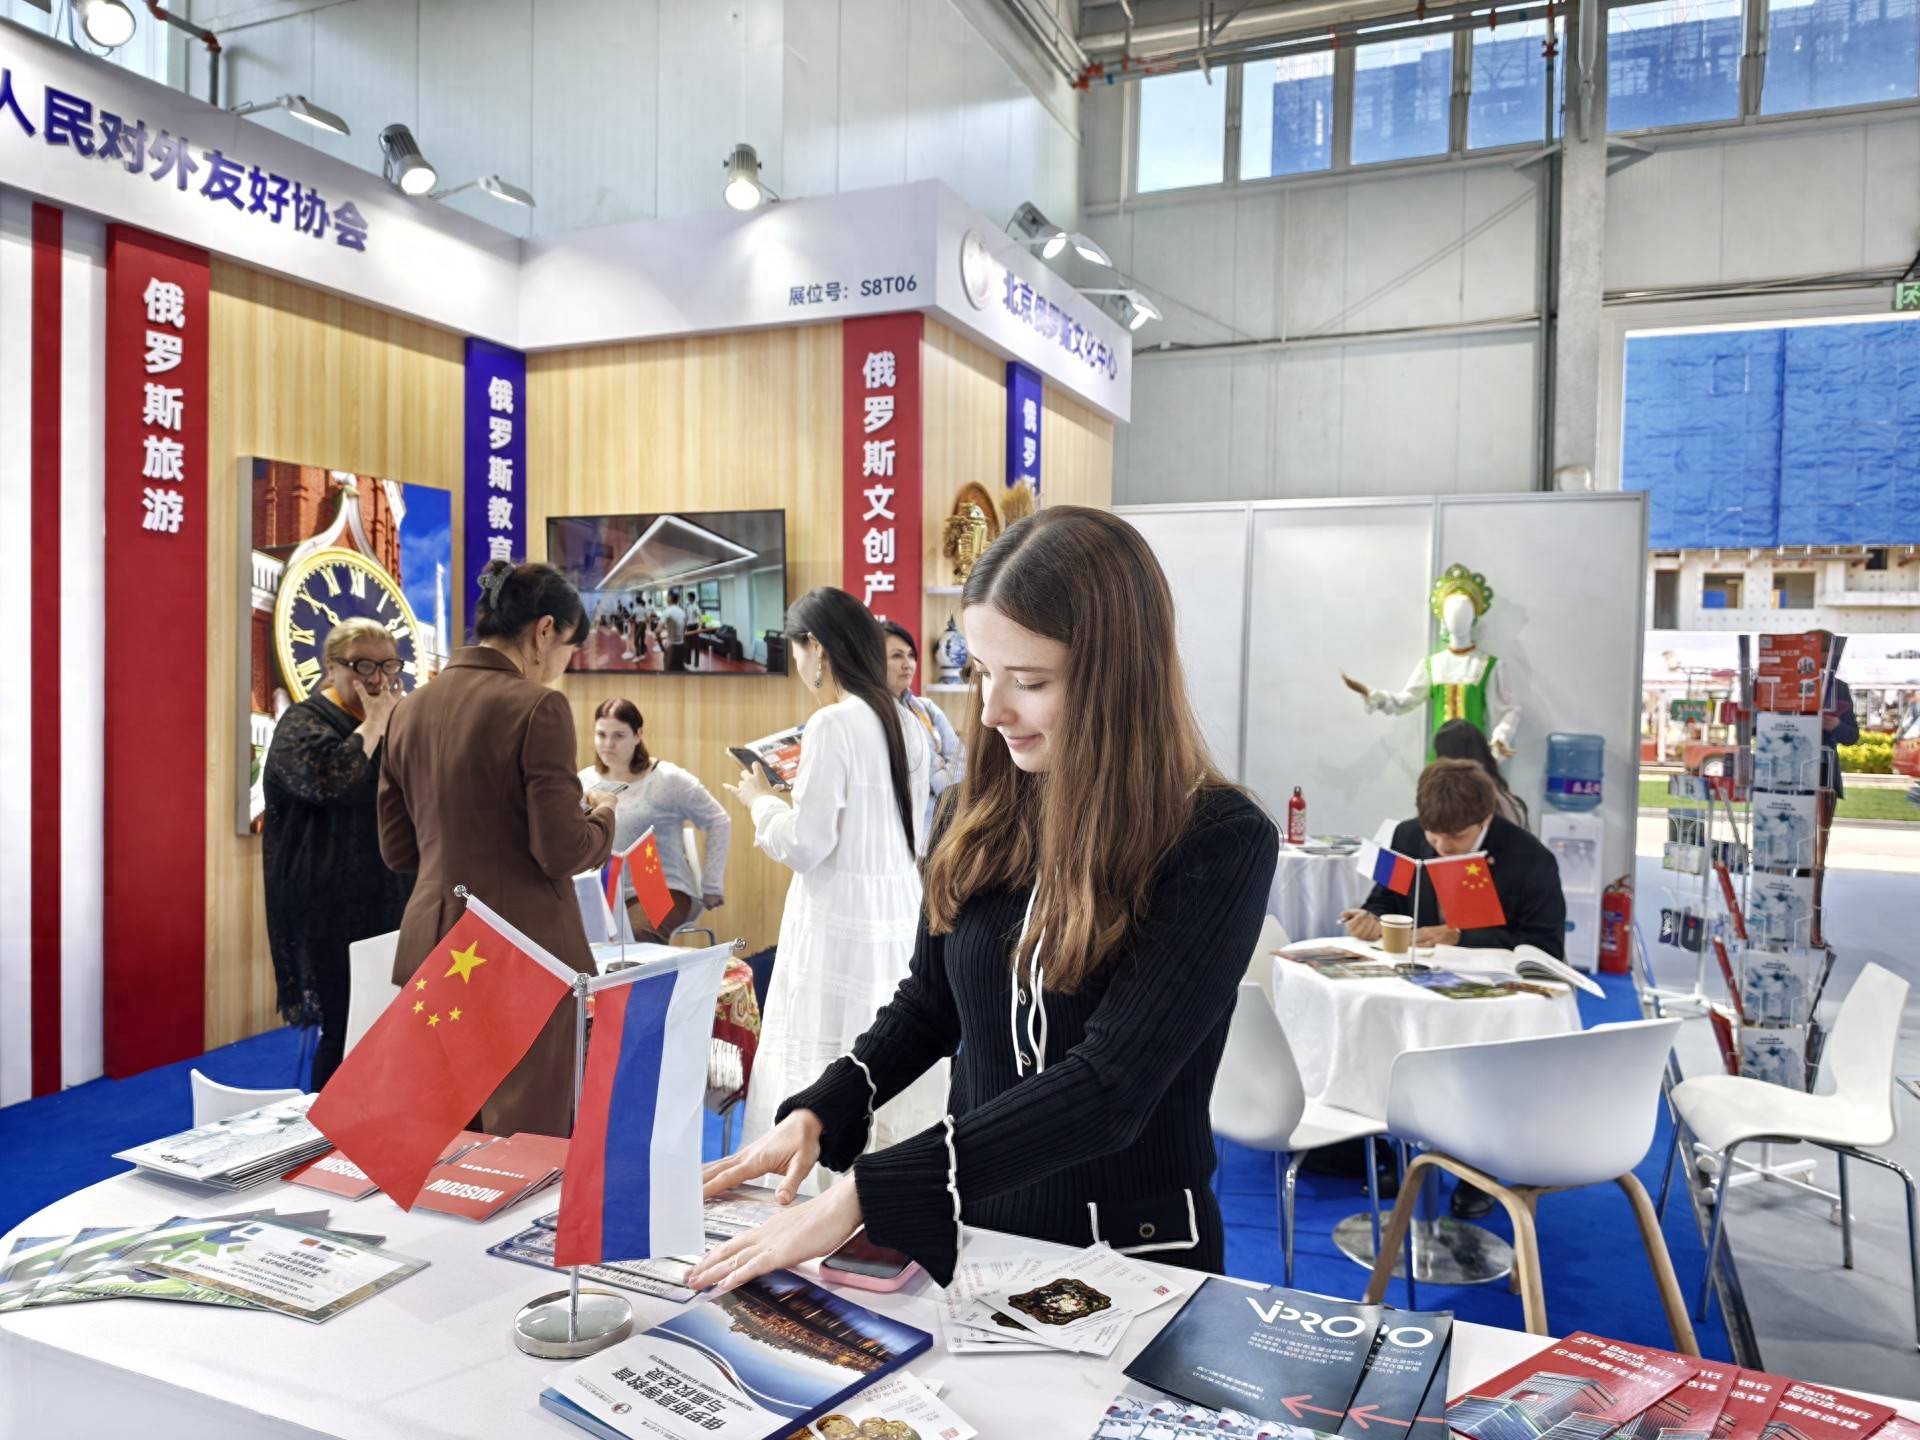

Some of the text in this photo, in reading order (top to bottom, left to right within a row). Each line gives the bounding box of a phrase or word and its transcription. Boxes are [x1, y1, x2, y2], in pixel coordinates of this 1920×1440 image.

[0, 67, 368, 253] 人民对外友好协会
[860, 275, 917, 296] S8T06
[142, 276, 186, 535] 俄罗斯旅游
[861, 350, 897, 626] 俄罗斯文创产
[611, 1367, 727, 1431] 俄罗斯高等教育
[1608, 1345, 1648, 1362] Bank
